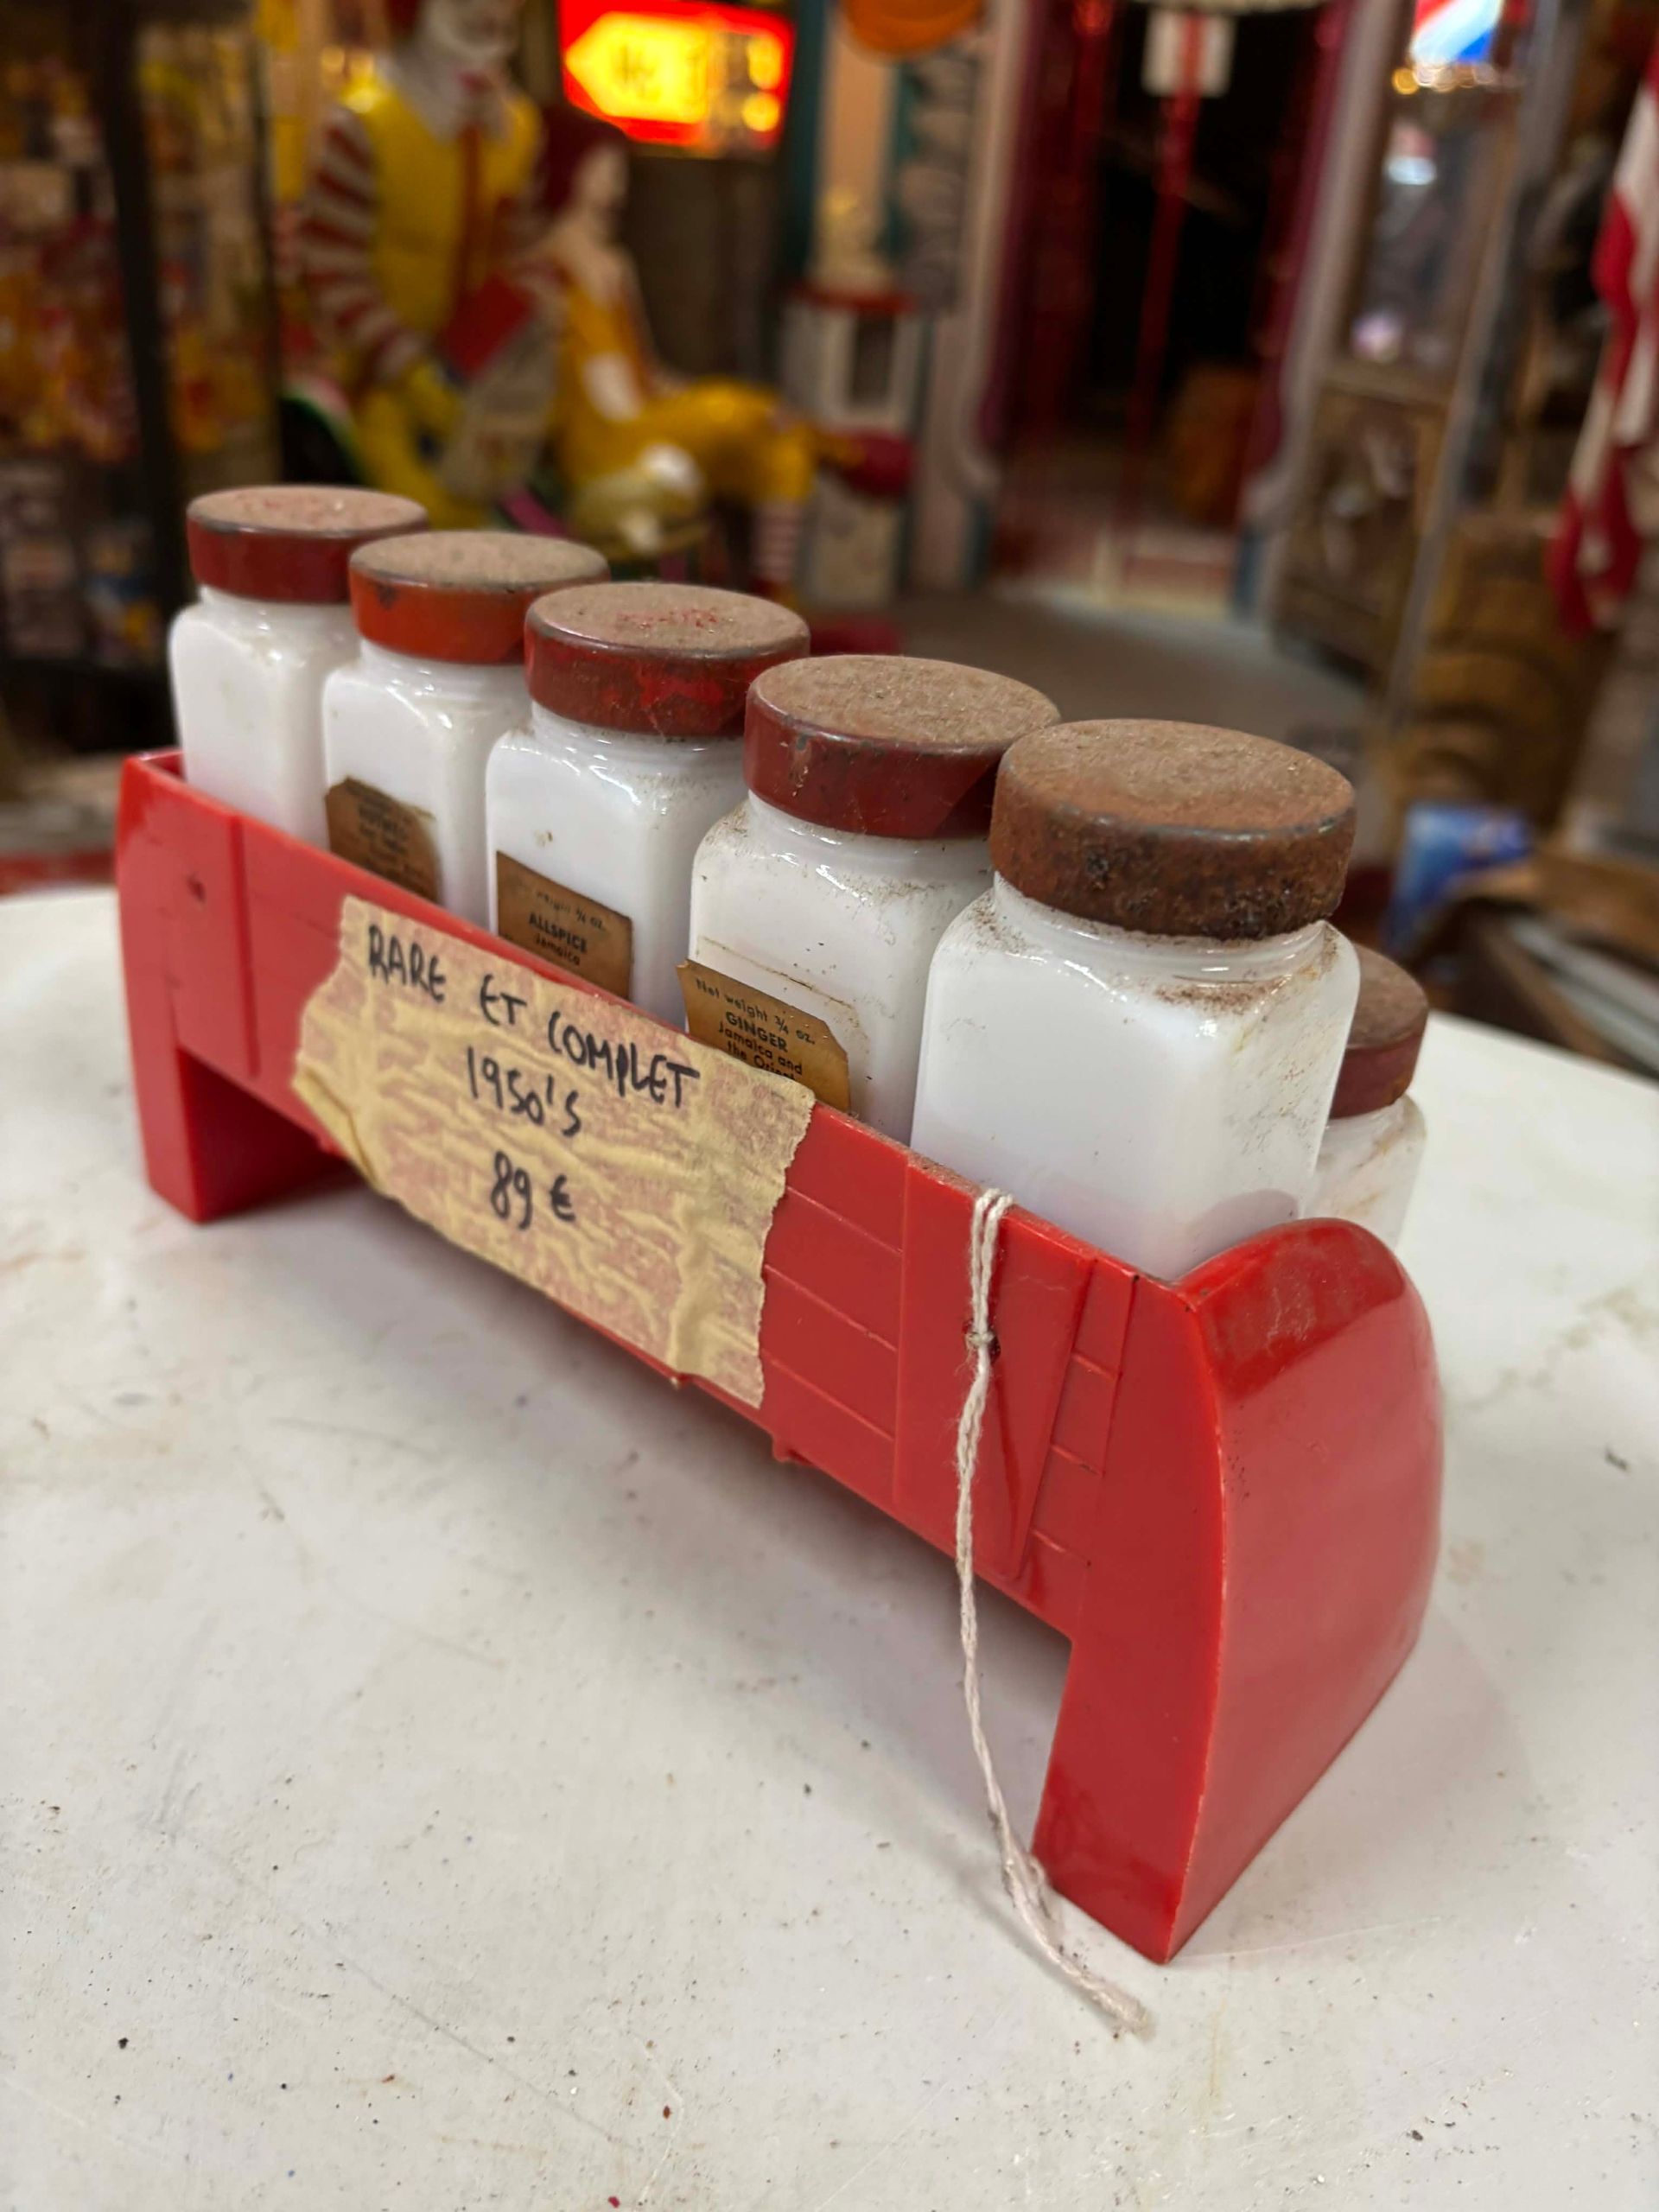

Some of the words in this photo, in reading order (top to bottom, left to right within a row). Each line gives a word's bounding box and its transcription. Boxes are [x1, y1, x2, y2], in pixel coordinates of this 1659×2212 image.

[529, 912, 587, 953] ALLSPICE
[535, 933, 580, 966] Jamaica
[368, 924, 446, 1003] RARE
[480, 973, 526, 1026] ET
[548, 1010, 700, 1109] COMPLET
[695, 977, 720, 999] Net
[724, 995, 768, 1022] weight
[718, 1020, 772, 1059] Jamaica
[778, 1053, 803, 1076] and
[725, 1011, 788, 1053] GINGER
[727, 1041, 747, 1062] the
[489, 1150, 533, 1230] 89
[549, 1174, 576, 1221] €
